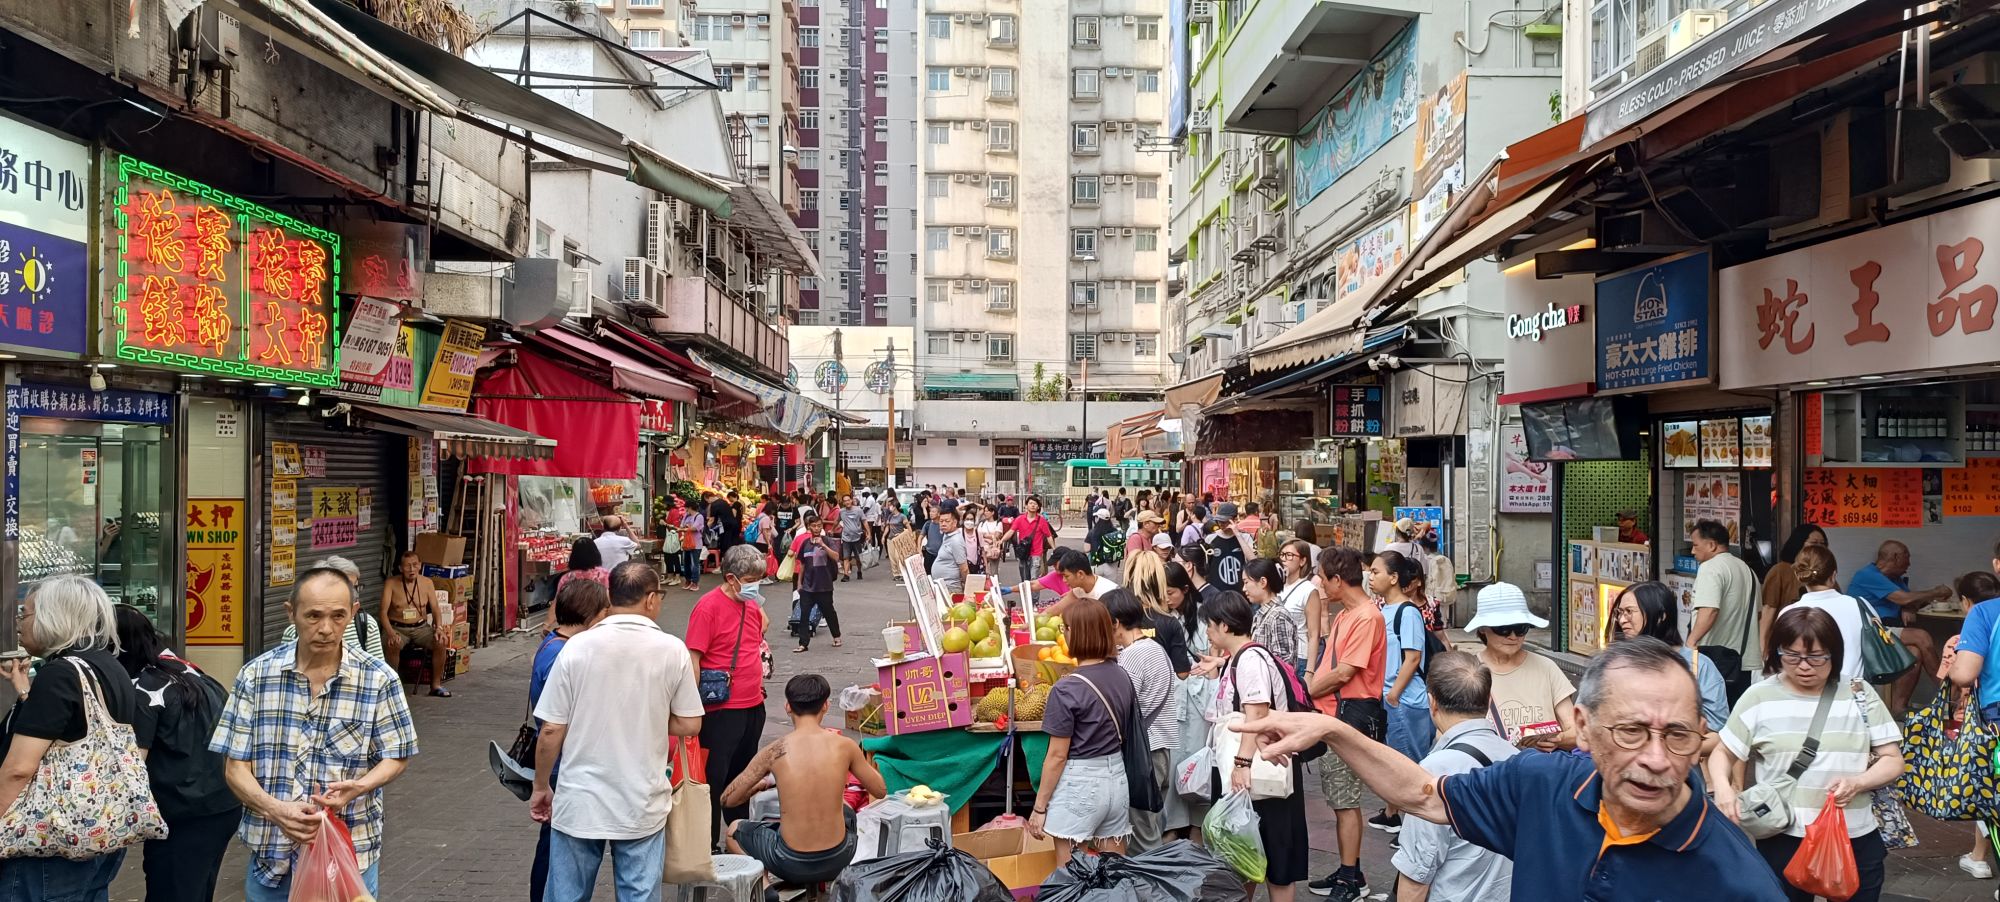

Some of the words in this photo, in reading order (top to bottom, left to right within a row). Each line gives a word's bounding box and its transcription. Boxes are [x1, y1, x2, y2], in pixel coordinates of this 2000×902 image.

[1773, 1, 1808, 33] 零添加
[1618, 92, 1647, 119] BLESS
[1731, 24, 1766, 57] JUICE
[1638, 299, 1664, 311] HOT
[1756, 236, 1998, 355] 蛇王品
[1507, 312, 1541, 341] Gong
[1541, 302, 1567, 330] cha
[1636, 308, 1664, 321] STAR
[262, 302, 327, 367] 大押
[358, 336, 378, 354] 6187
[376, 341, 392, 357] 9051
[1606, 328, 1698, 369] 豪大大雞排
[1605, 368, 1640, 380] HOT-STAR
[1641, 366, 1656, 377] Large
[1657, 364, 1672, 373] Fried
[1674, 361, 1697, 370] Chicken
[351, 383, 366, 394] 2810
[1350, 388, 1365, 433] 手抓餅
[187, 504, 234, 529] 大押
[1843, 512, 1860, 523] $69
[1861, 512, 1878, 523] $49
[207, 530, 238, 543] SHOP
